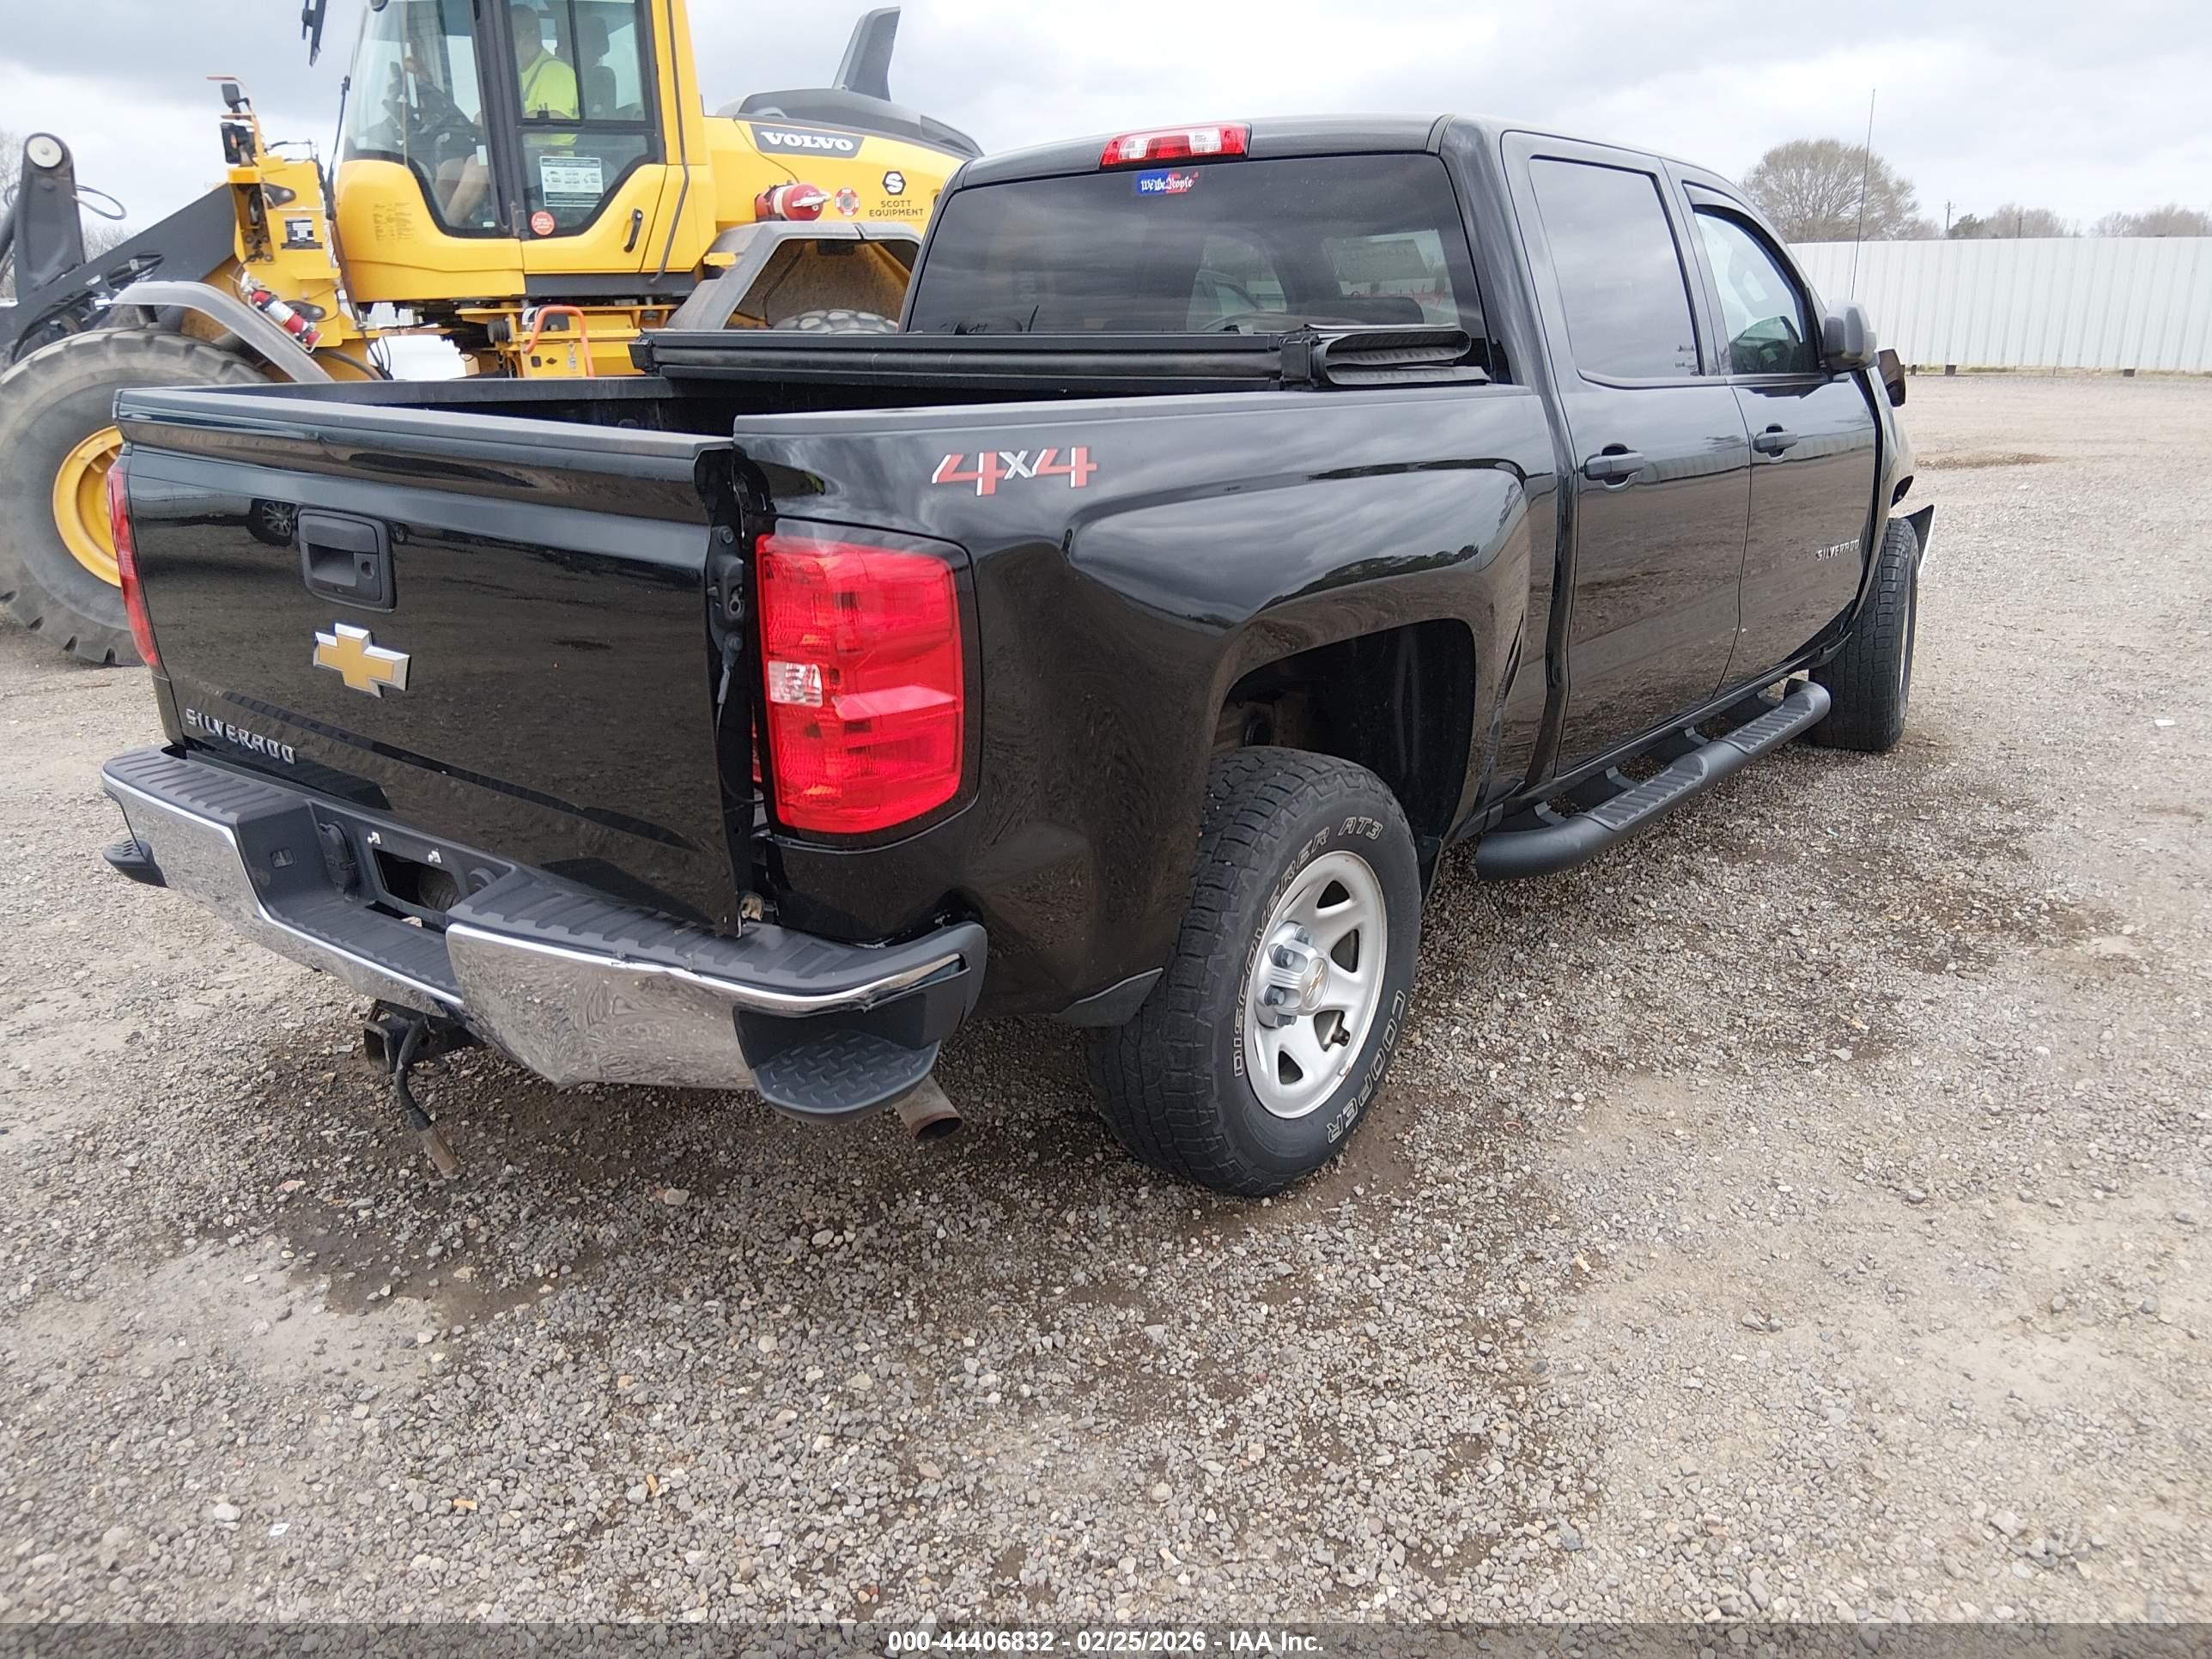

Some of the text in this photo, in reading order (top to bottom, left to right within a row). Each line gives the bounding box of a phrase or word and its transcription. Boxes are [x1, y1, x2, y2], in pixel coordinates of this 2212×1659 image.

[760, 131, 854, 151] VOLVO
[868, 208, 924, 217] EQUIPMENT
[880, 199, 913, 208] SCOTT
[1814, 538, 1860, 562] SILVERADO
[185, 708, 296, 765] SILVERADO
[1338, 816, 1384, 841] AT3
[1326, 989, 1407, 1144] COOPER
